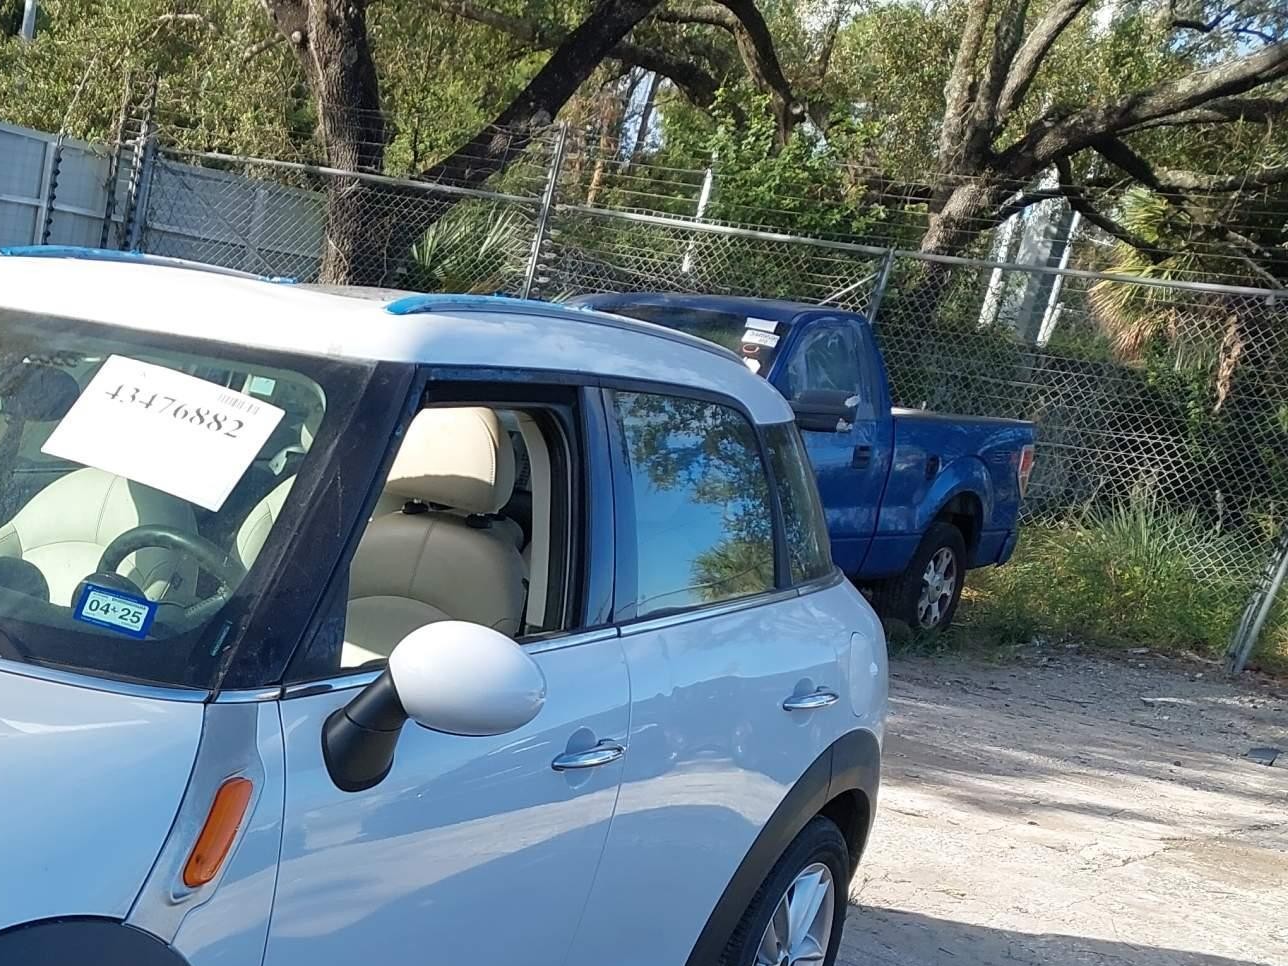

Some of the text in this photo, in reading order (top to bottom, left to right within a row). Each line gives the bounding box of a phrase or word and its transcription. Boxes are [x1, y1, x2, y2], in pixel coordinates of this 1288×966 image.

[105, 384, 244, 438] 43476882
[89, 599, 110, 615] 04
[119, 608, 142, 624] 25
